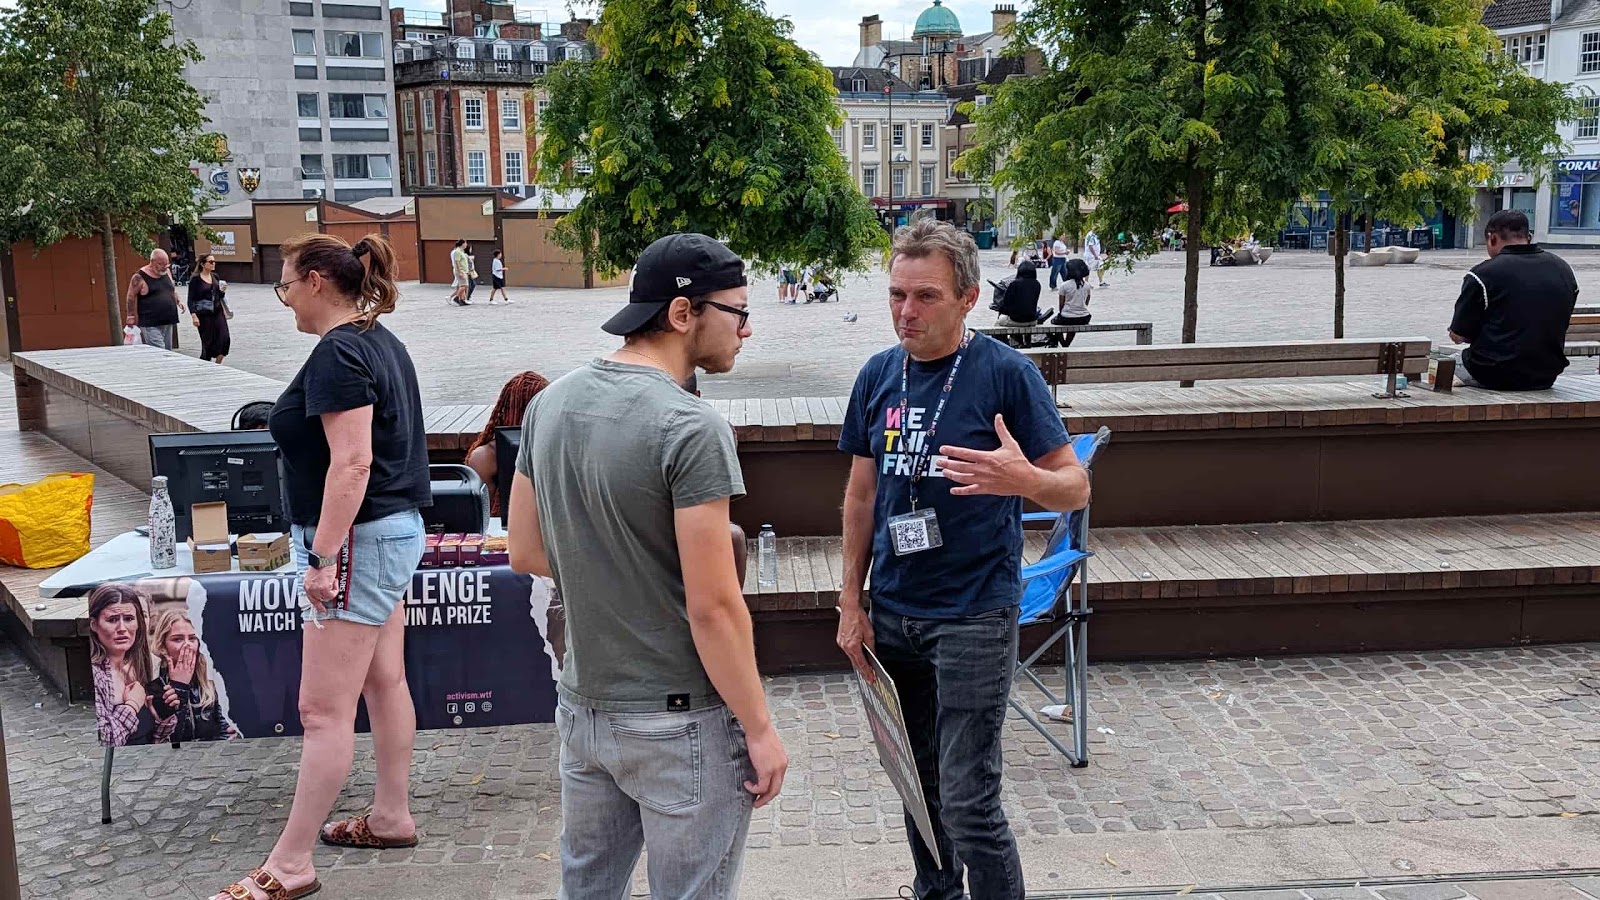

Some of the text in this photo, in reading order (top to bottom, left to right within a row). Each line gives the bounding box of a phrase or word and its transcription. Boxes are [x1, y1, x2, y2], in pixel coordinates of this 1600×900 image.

[1558, 161, 1598, 171] CORAL
[886, 407, 926, 429] WE
[339, 572, 348, 592] PARIS
[238, 611, 296, 633] WATCH
[431, 606, 443, 626] A
[447, 604, 492, 625] PRIZE
[446, 690, 493, 701] activism.wtf
